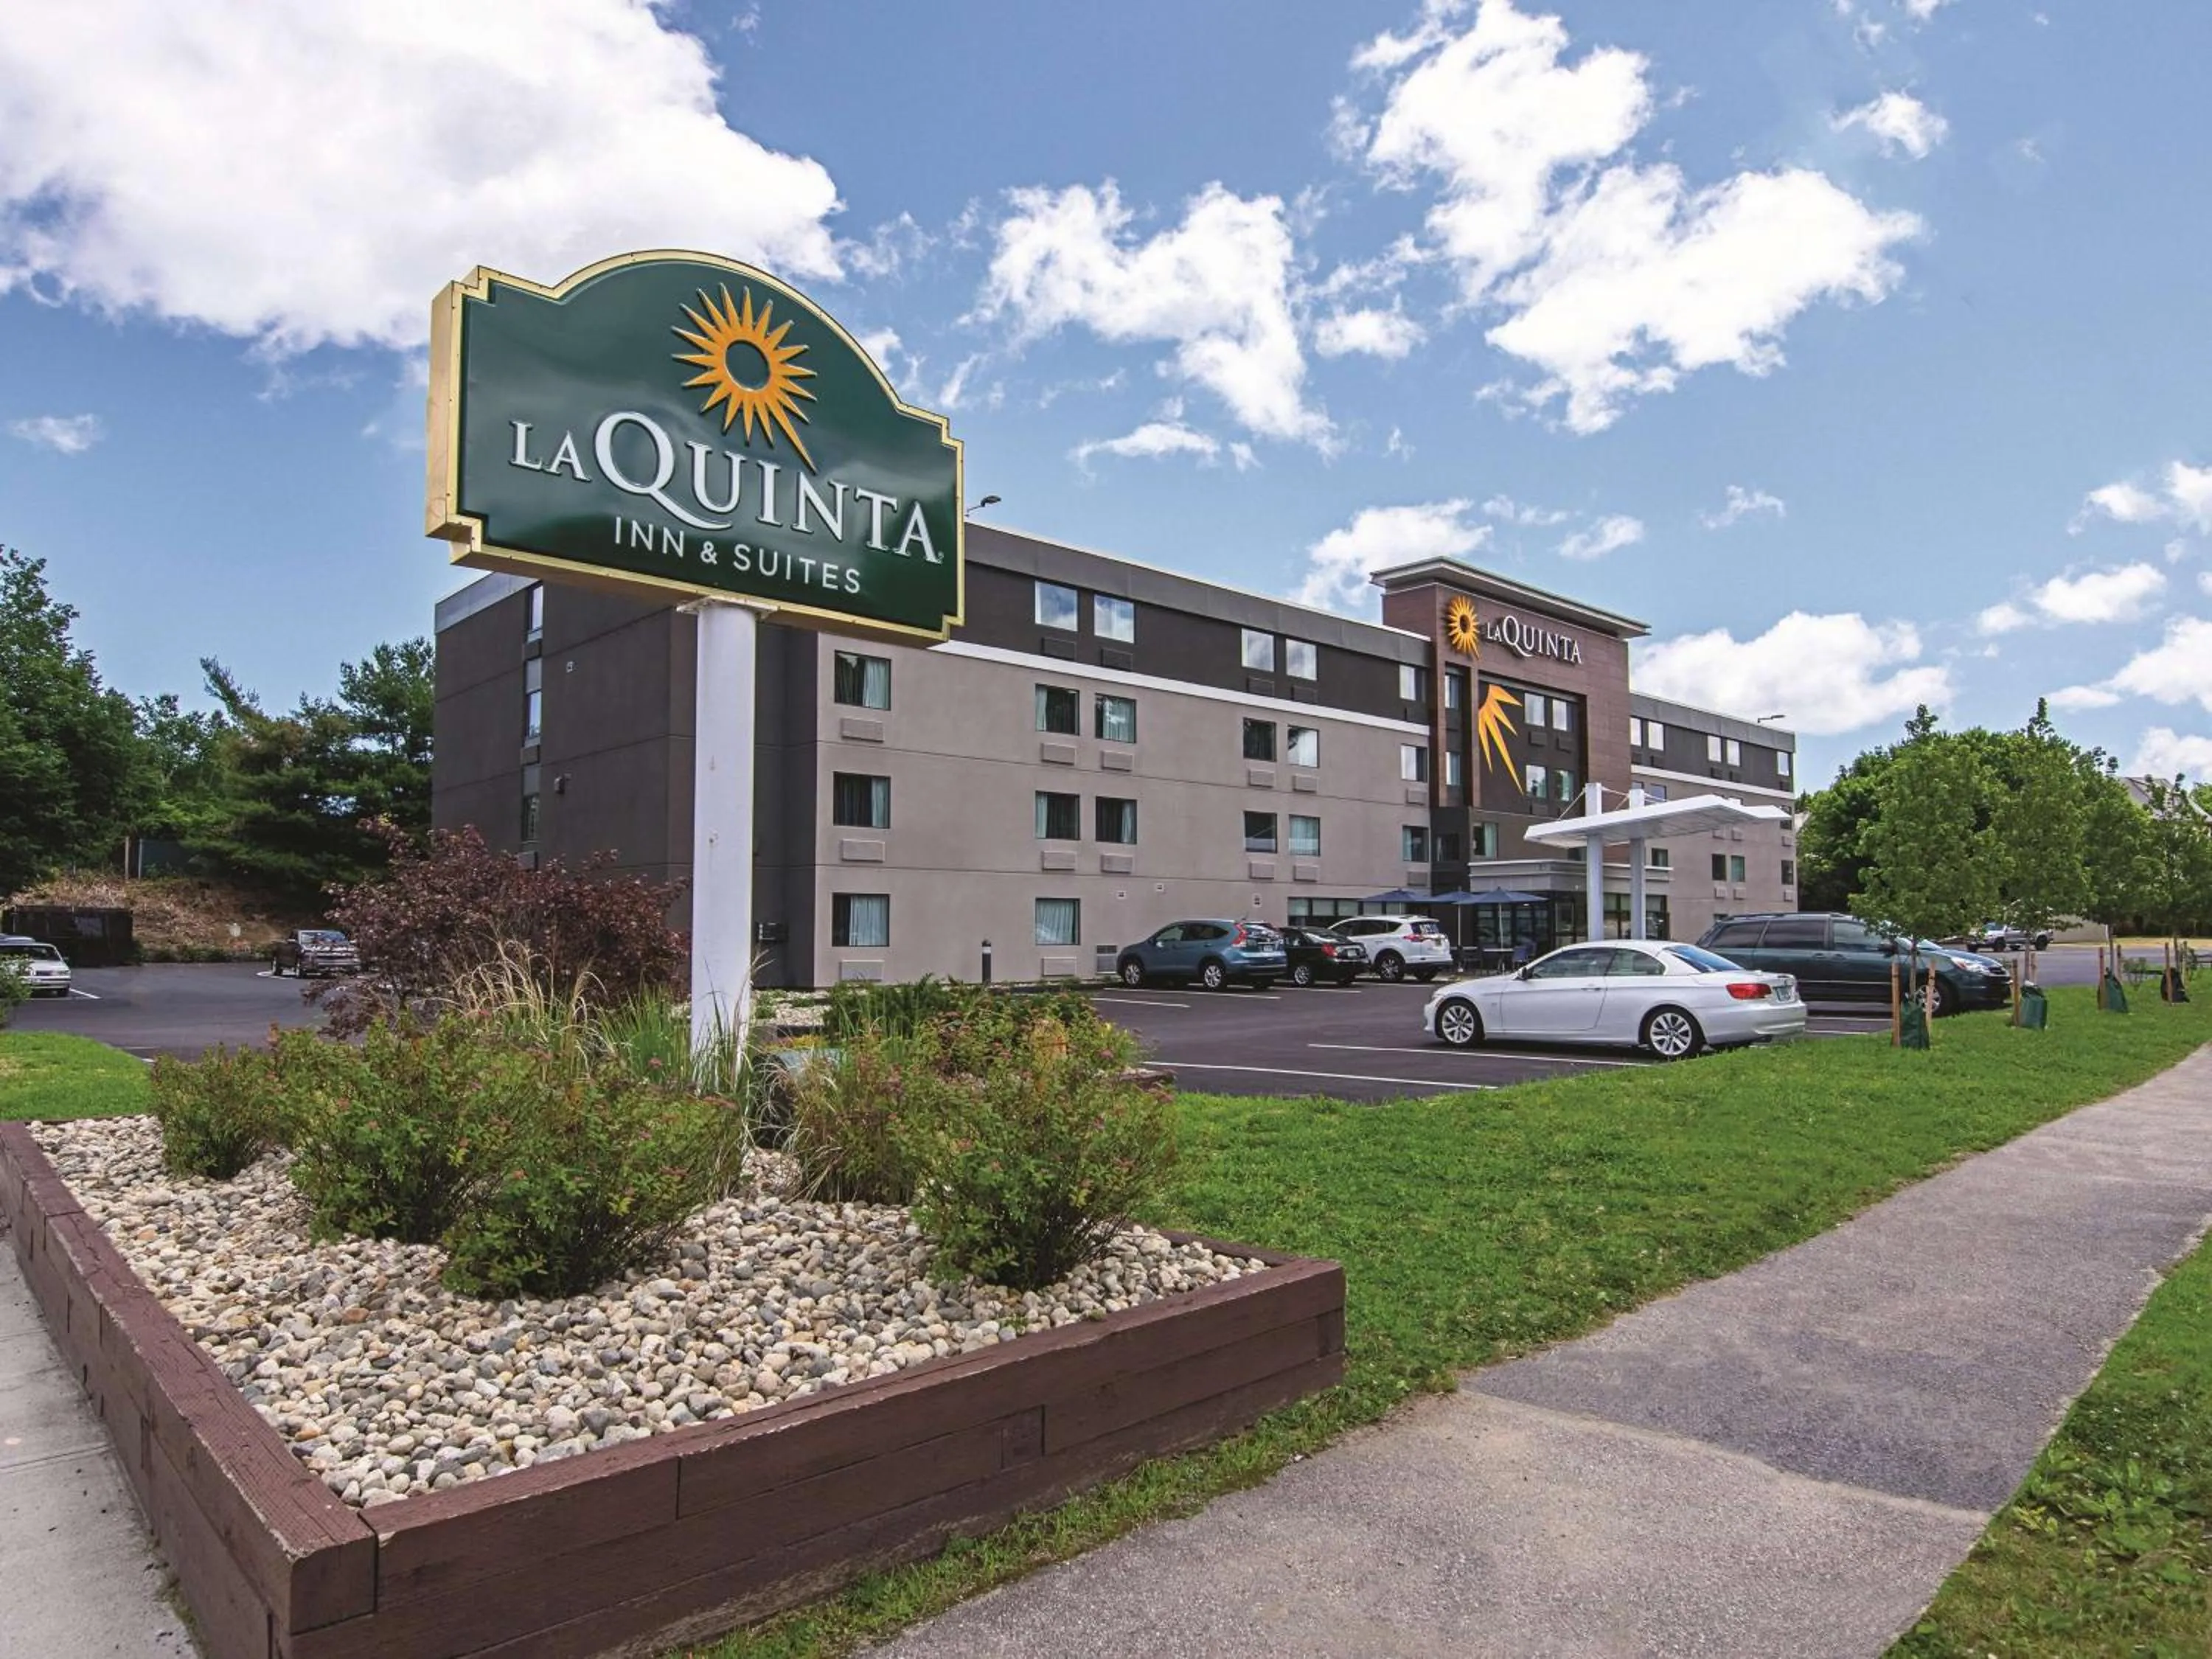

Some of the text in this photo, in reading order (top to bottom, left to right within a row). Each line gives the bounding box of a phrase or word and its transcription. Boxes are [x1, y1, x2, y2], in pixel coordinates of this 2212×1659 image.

[509, 411, 944, 564] LA QUINTA
[615, 517, 860, 594] INN & SUITES
[1486, 615, 1582, 664] LA QUINTA
